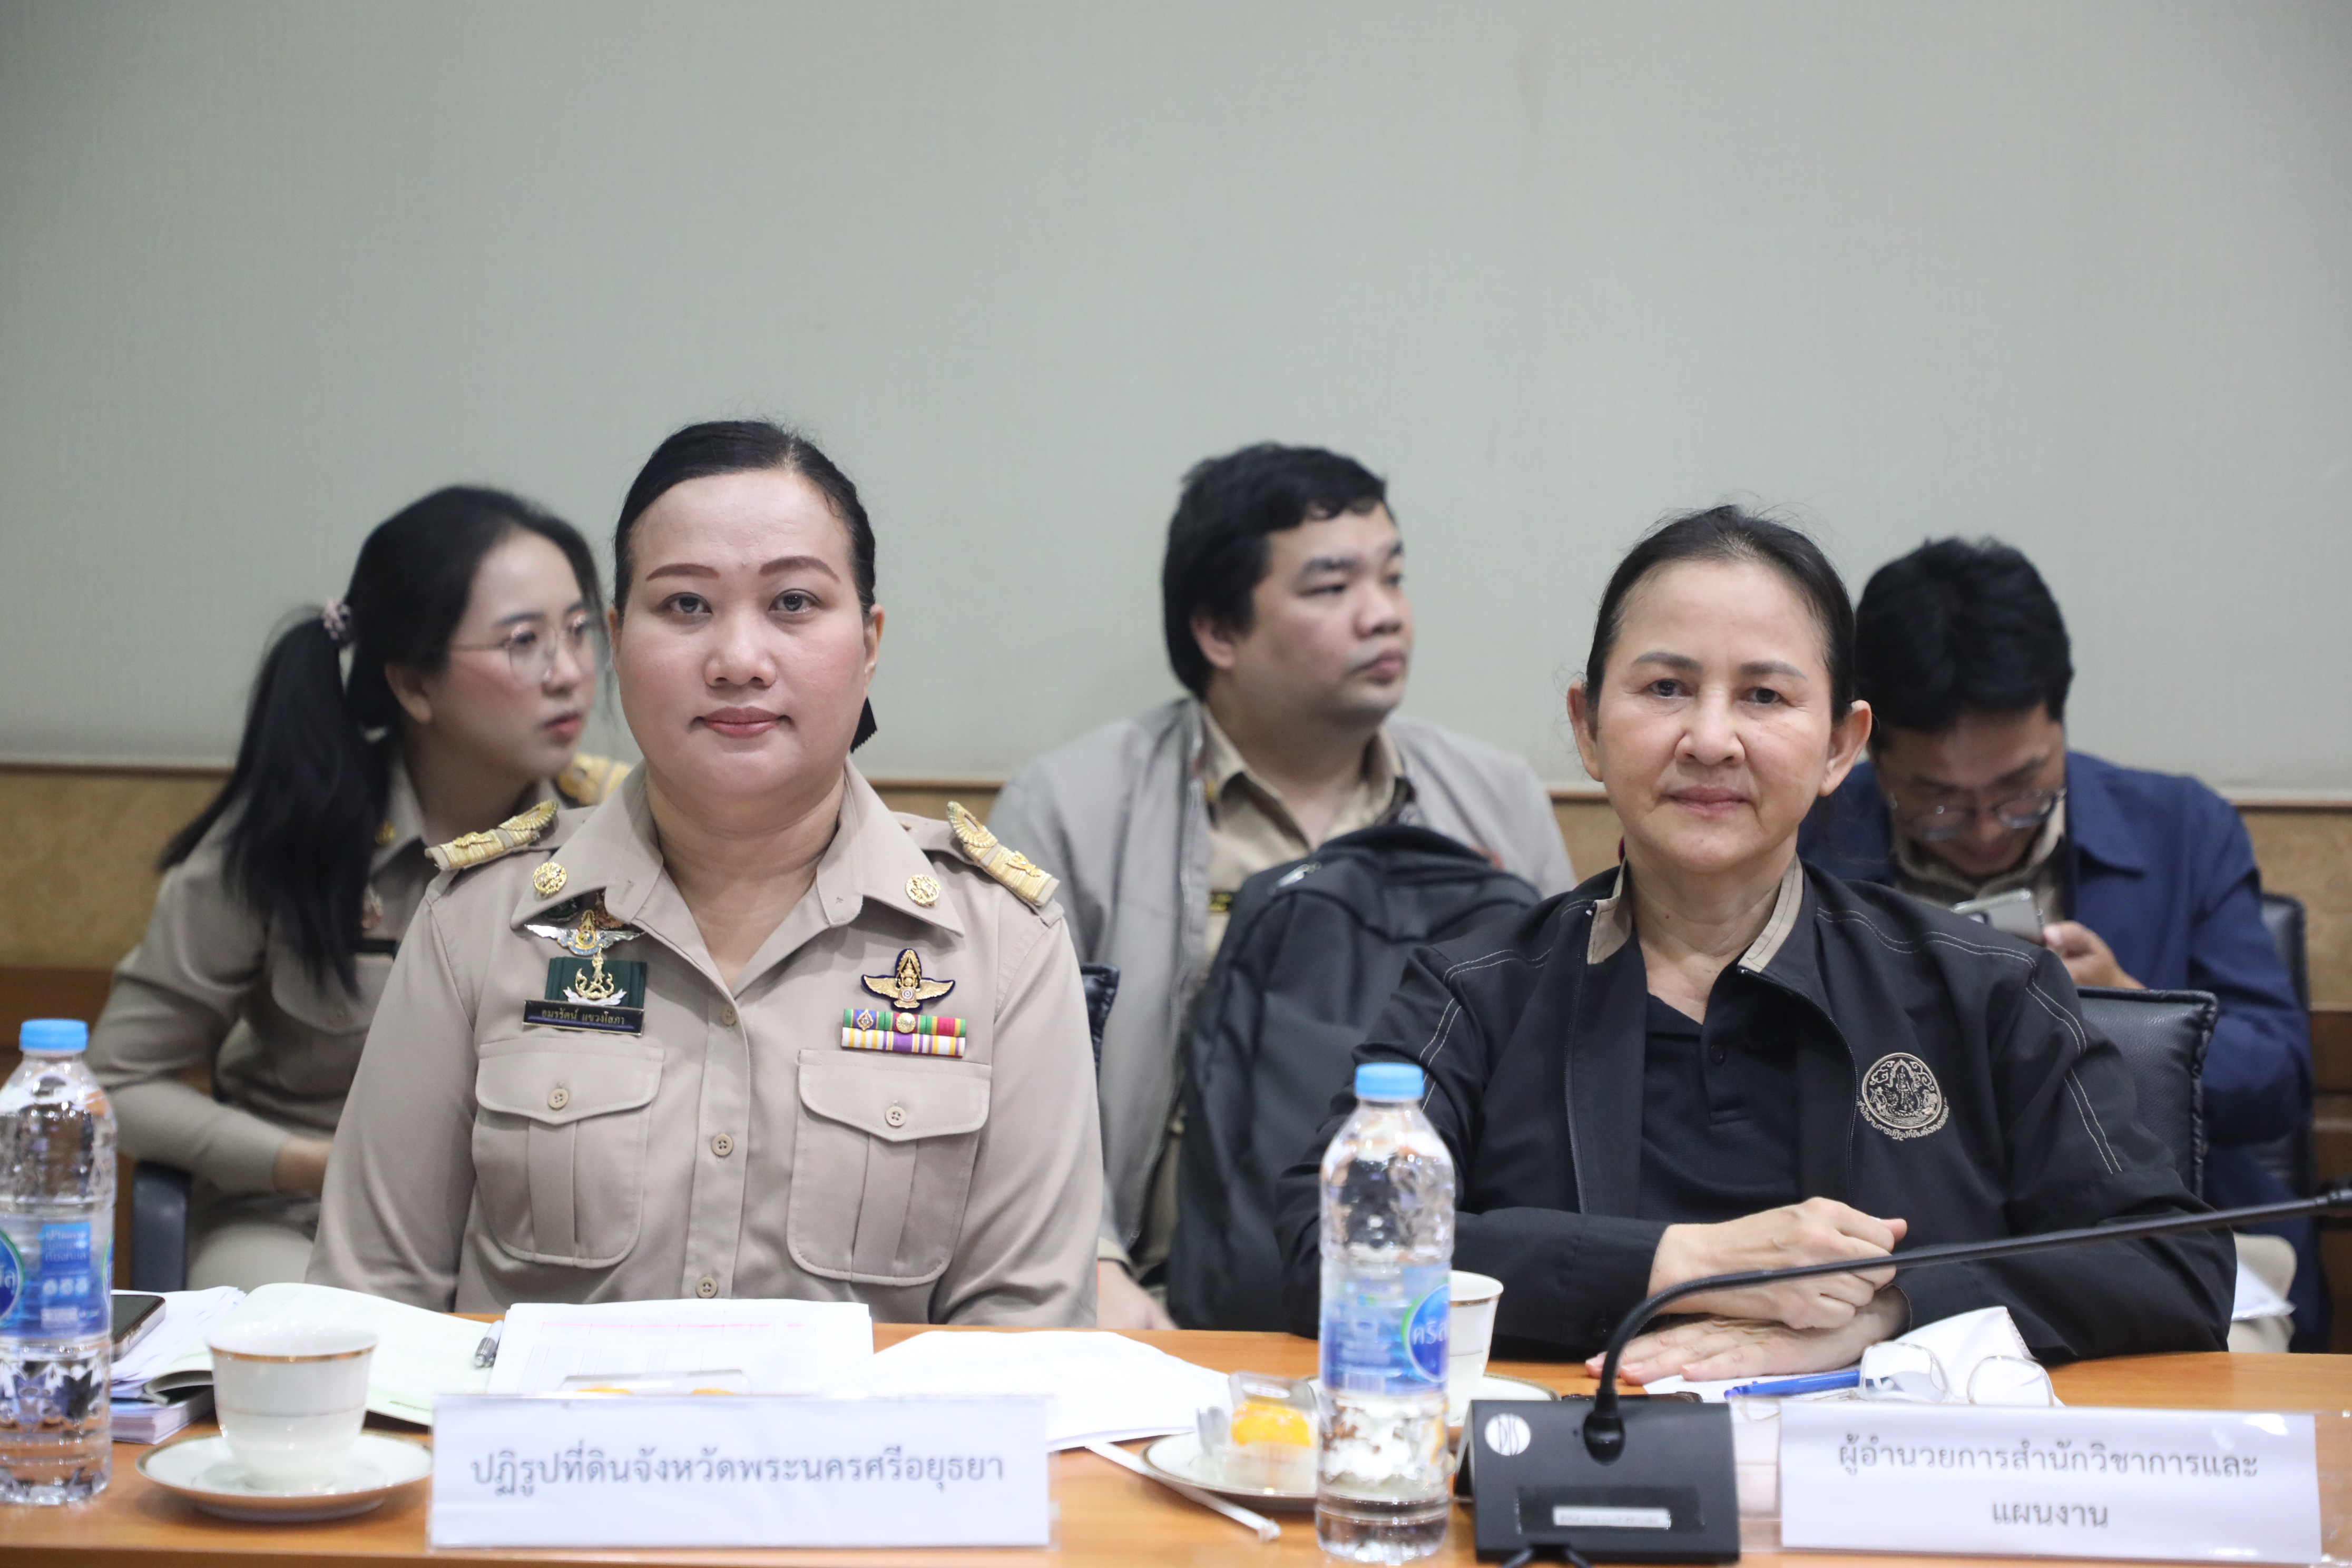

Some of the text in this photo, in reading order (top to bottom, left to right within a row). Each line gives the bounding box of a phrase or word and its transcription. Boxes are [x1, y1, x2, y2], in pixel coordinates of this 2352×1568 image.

[470, 1440, 1003, 1496] ปฏิรูปที่ดินจังหวัดพระนครศรีอยุธยา
[1839, 1433, 2258, 1477] ผู้อำนวยการสำนักวิชาการและ
[1993, 1502, 2108, 1528] แผนงาน
